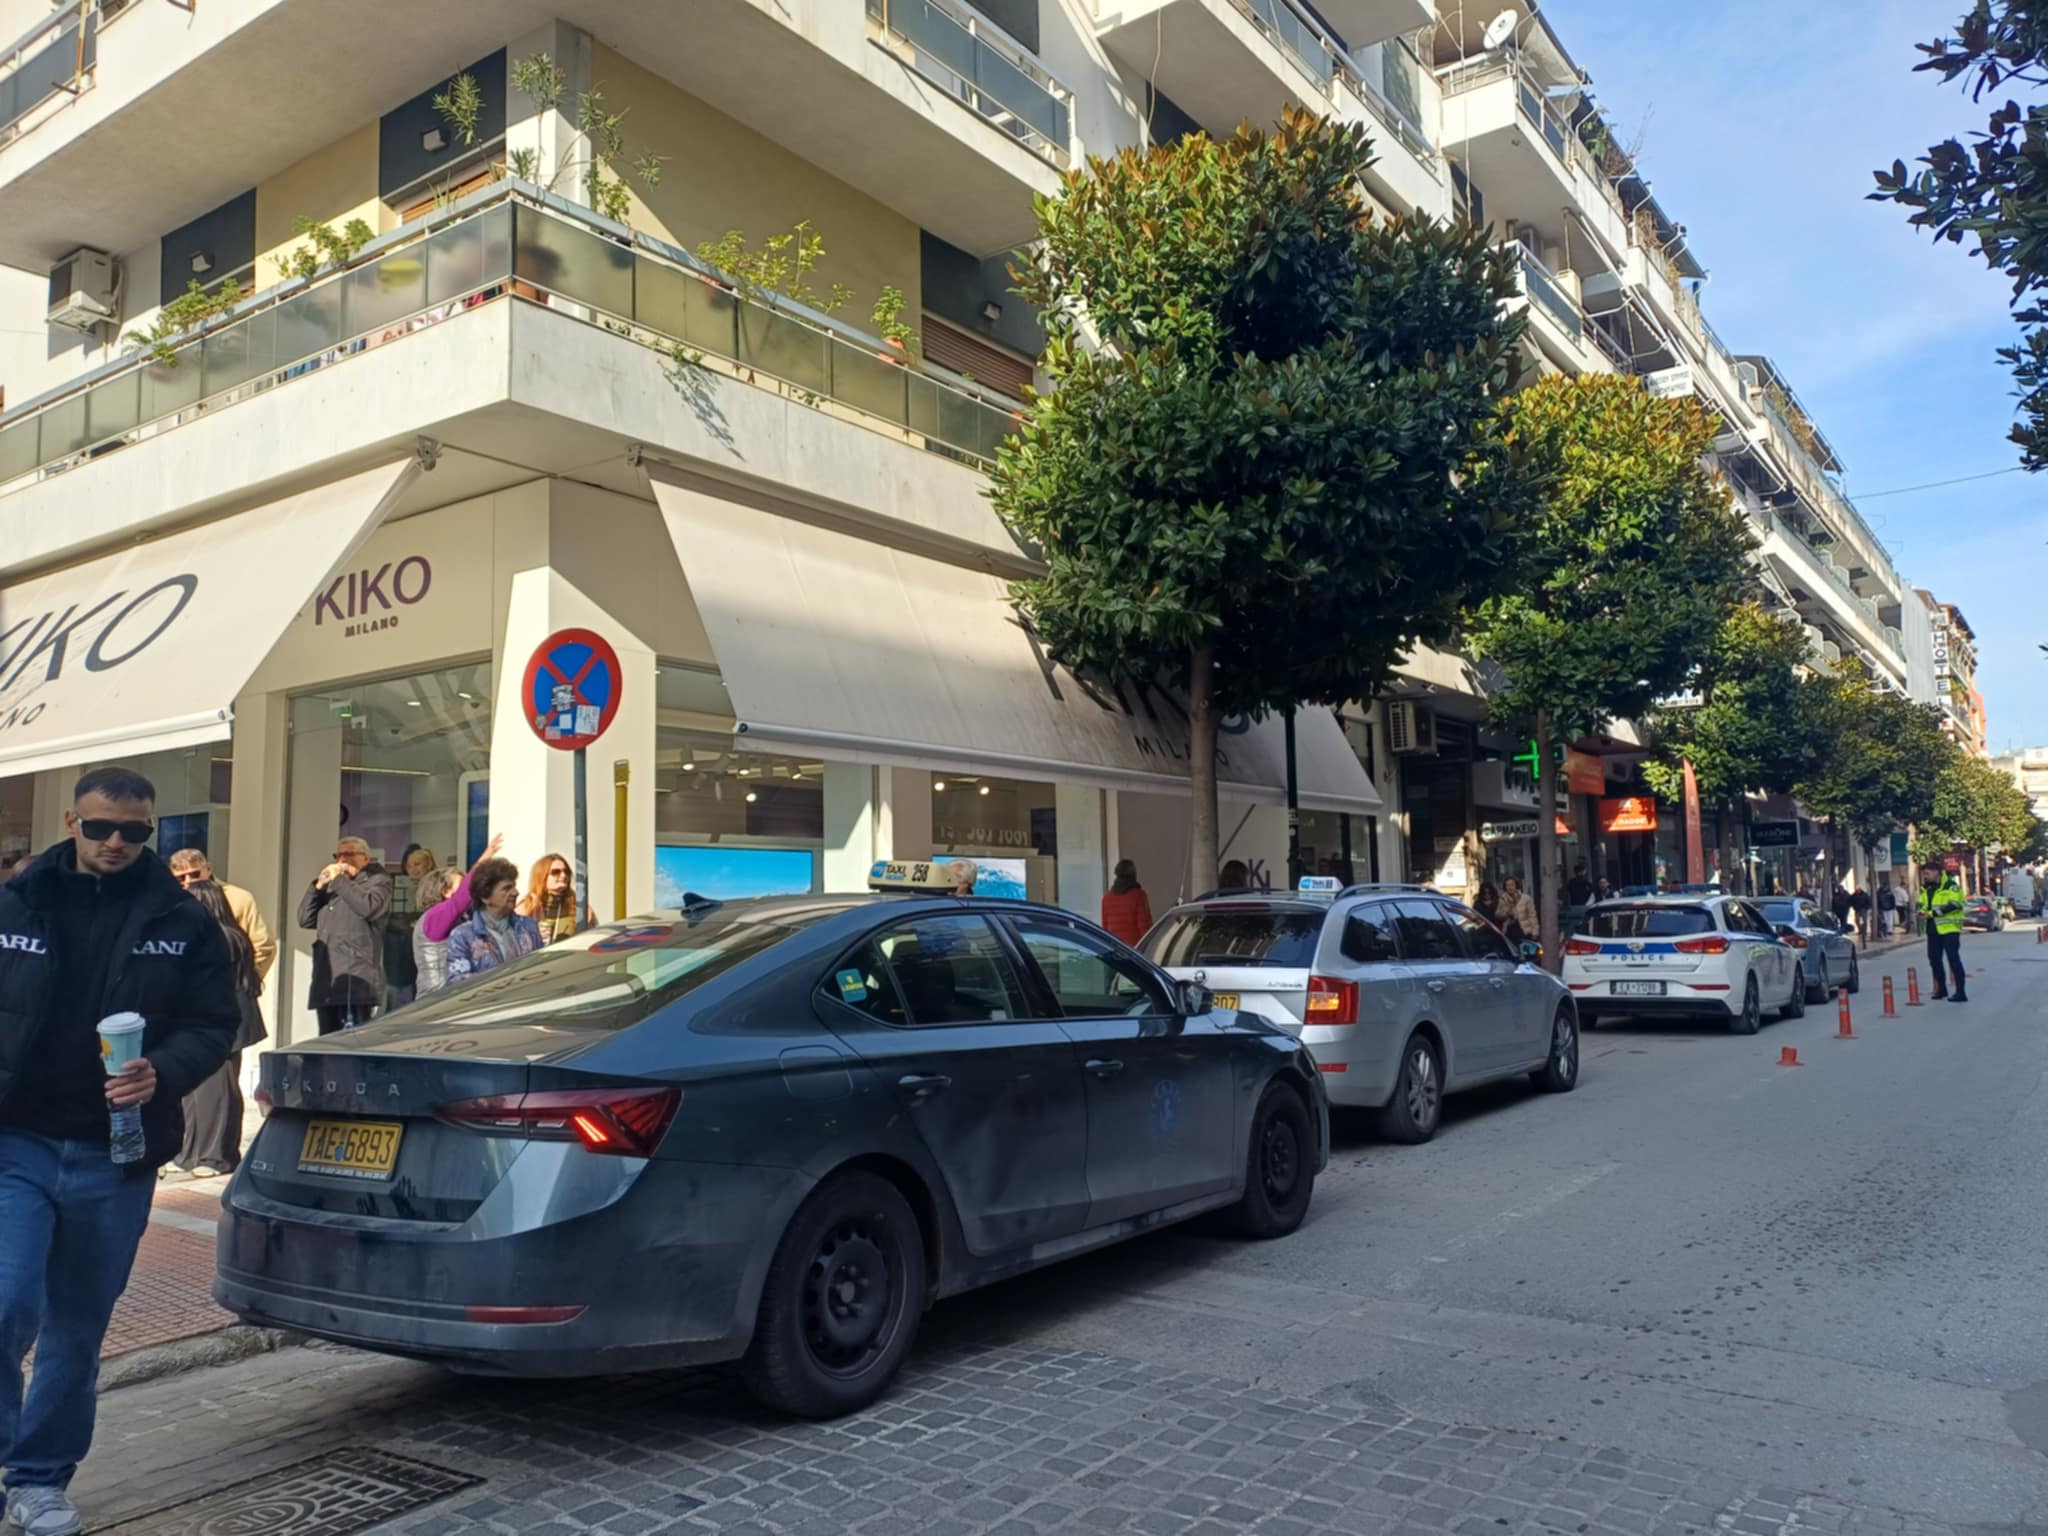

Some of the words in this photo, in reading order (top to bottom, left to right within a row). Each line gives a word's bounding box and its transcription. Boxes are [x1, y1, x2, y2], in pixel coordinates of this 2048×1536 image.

[314, 555, 432, 626] KIKO
[344, 616, 399, 637] MILANO
[1934, 634, 1949, 707] HOTEL
[1134, 735, 1229, 767] MILO
[887, 864, 906, 874] TAXI
[0, 933, 47, 955] ARL
